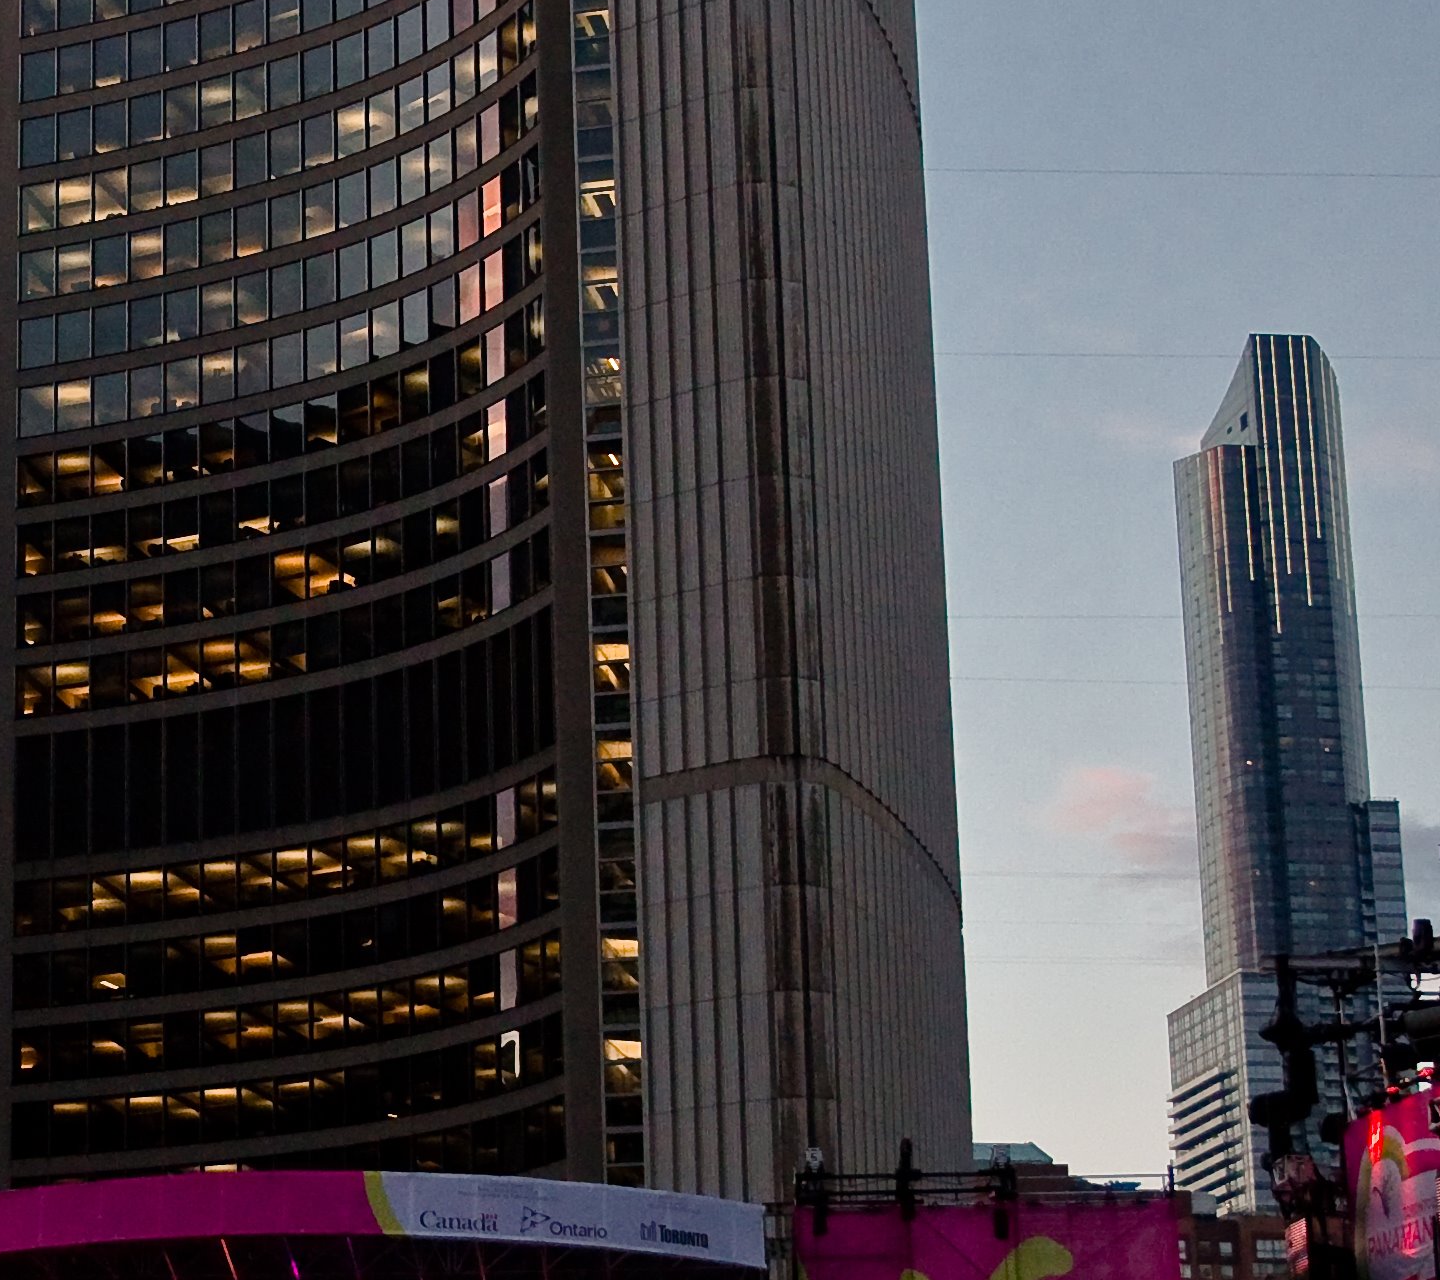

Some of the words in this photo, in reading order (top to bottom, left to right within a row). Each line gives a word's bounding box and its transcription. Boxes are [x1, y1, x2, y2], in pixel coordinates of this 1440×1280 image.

[420, 1209, 499, 1232] Canada
[549, 1220, 608, 1239] Ontario
[658, 1223, 710, 1249] TORONTO
